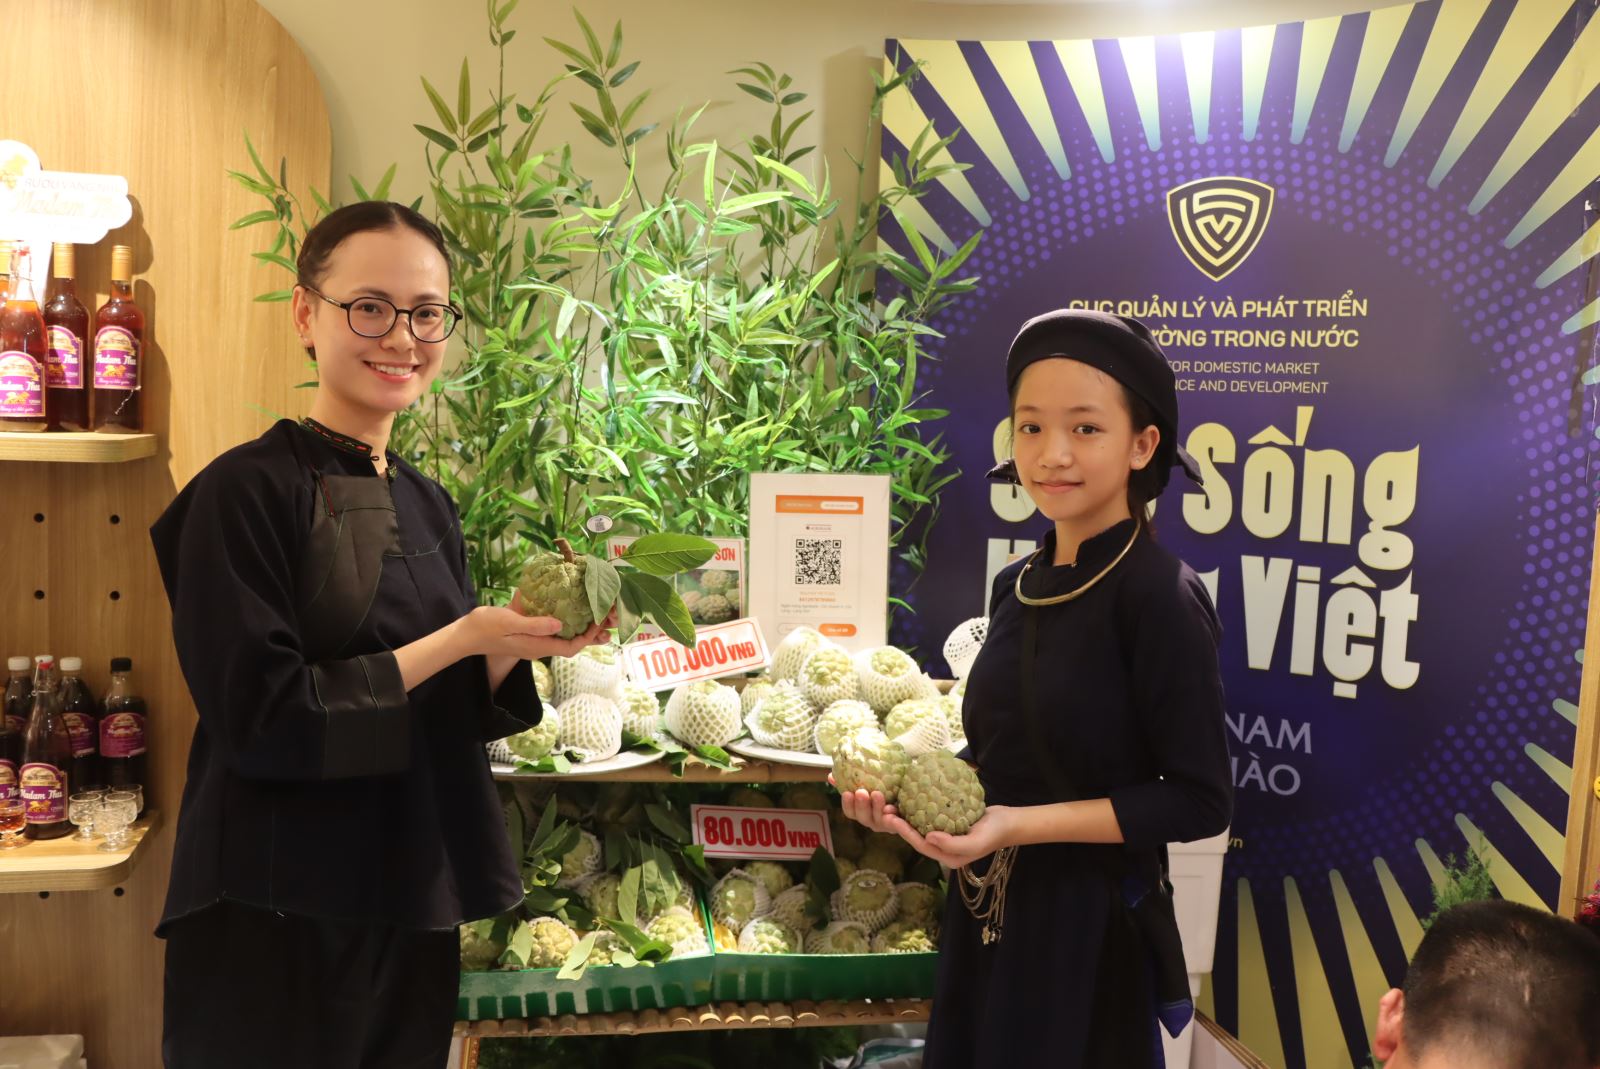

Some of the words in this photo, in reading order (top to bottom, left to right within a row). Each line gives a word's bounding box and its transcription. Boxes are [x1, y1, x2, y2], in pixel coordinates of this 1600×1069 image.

[1117, 294, 1178, 318] QUẢN
[1181, 296, 1208, 318] LÝ
[1210, 295, 1238, 318] VÀ
[1242, 295, 1299, 318] PHÁT
[1302, 289, 1368, 318] TRIỂN
[1211, 329, 1287, 347] TRONG
[1290, 324, 1360, 347] NƯỚC
[1194, 361, 1262, 374] DOMESTIC
[1265, 362, 1320, 374] MARKET
[1199, 380, 1228, 392] AND
[1230, 380, 1330, 393] DEVELOPMENT
[1183, 406, 1420, 571] Sống
[1240, 554, 1420, 700] Việt
[1225, 711, 1312, 754] NAM
